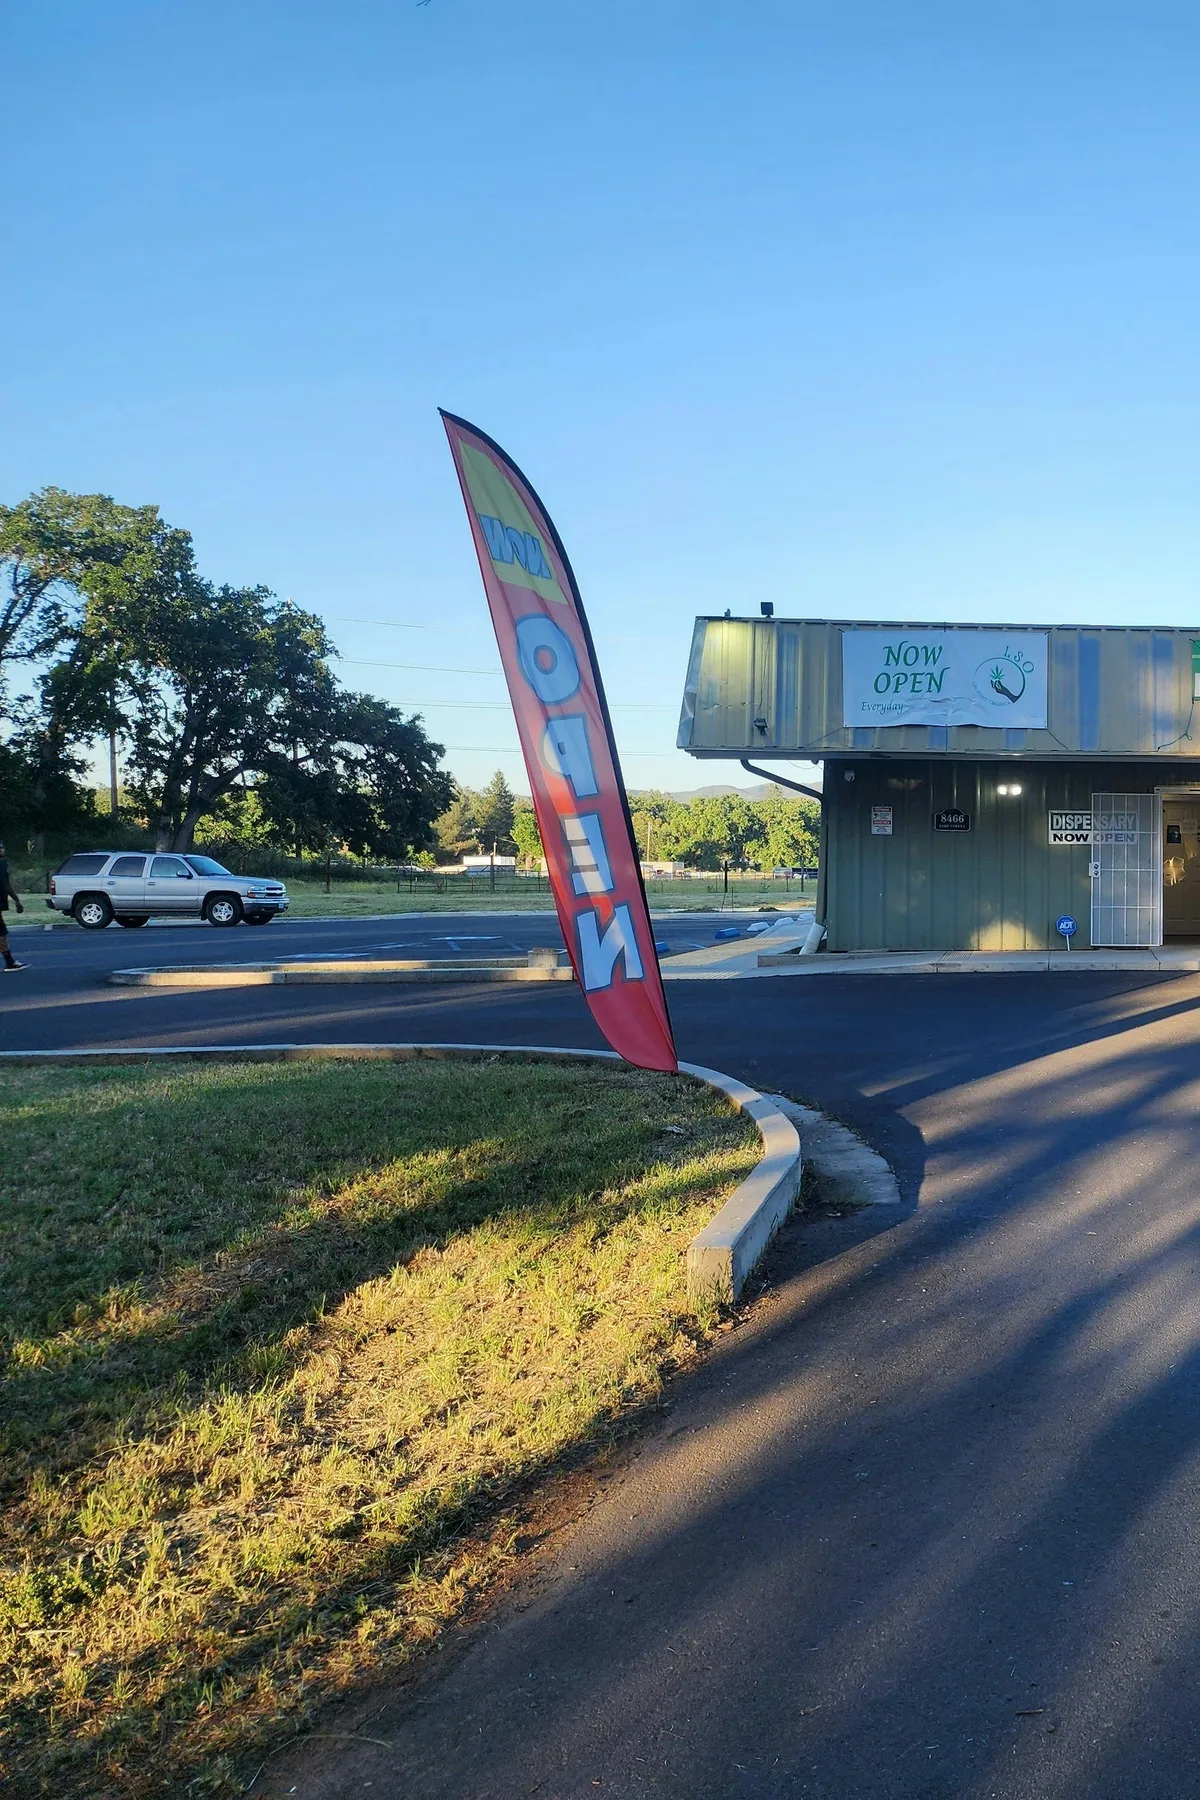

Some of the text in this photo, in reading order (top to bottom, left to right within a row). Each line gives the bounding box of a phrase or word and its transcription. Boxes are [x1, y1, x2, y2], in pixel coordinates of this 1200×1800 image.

[882, 640, 943, 667] NOW
[873, 666, 951, 694] OPEN
[861, 700, 904, 715] Everyday
[940, 813, 965, 823] 8466
[1052, 814, 1135, 830] DISPENSARY
[1053, 833, 1135, 842] NOW OPEN
[1059, 921, 1074, 930] ADT
